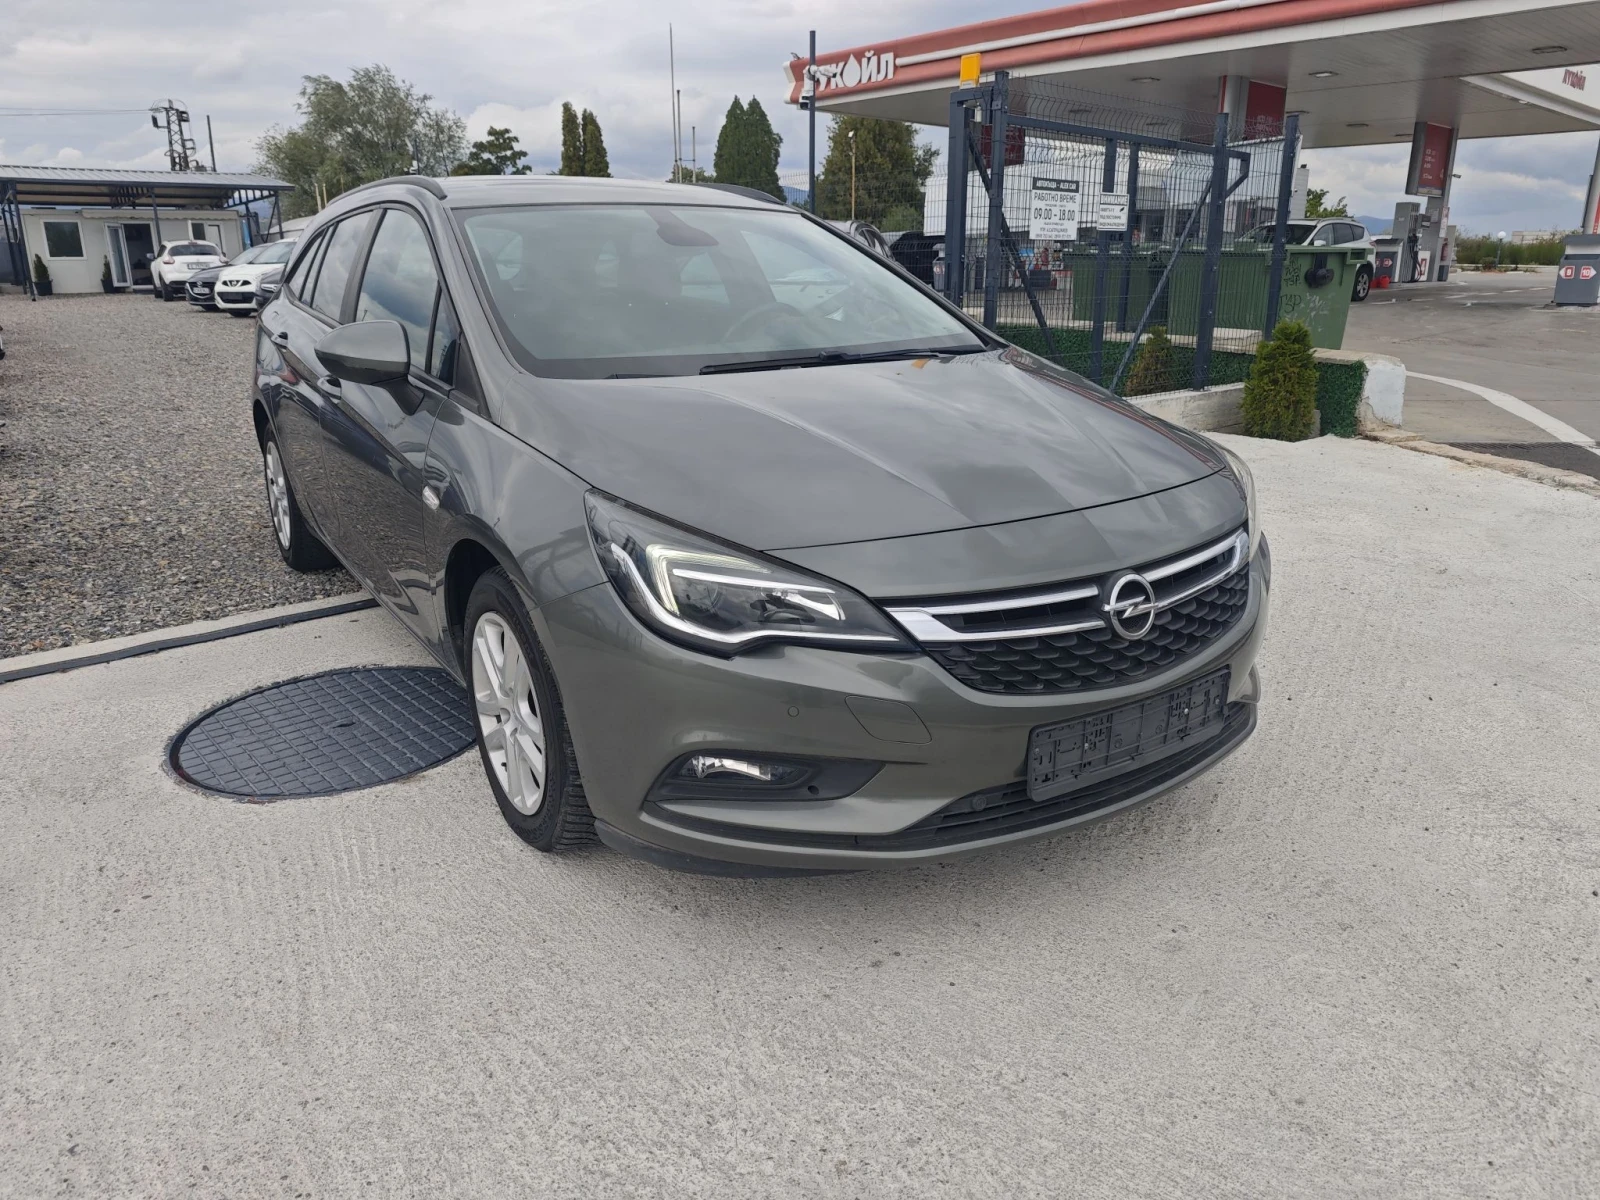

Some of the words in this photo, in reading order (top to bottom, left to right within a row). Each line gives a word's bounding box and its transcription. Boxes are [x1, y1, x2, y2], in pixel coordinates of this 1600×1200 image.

[805, 50, 895, 92] УКОЙЛ
[1034, 192, 1059, 202] РАБОТНО
[1060, 194, 1077, 203] ВРЕМЕ
[1034, 208, 1052, 220] 09.00
[1058, 209, 1076, 221] 18.00
